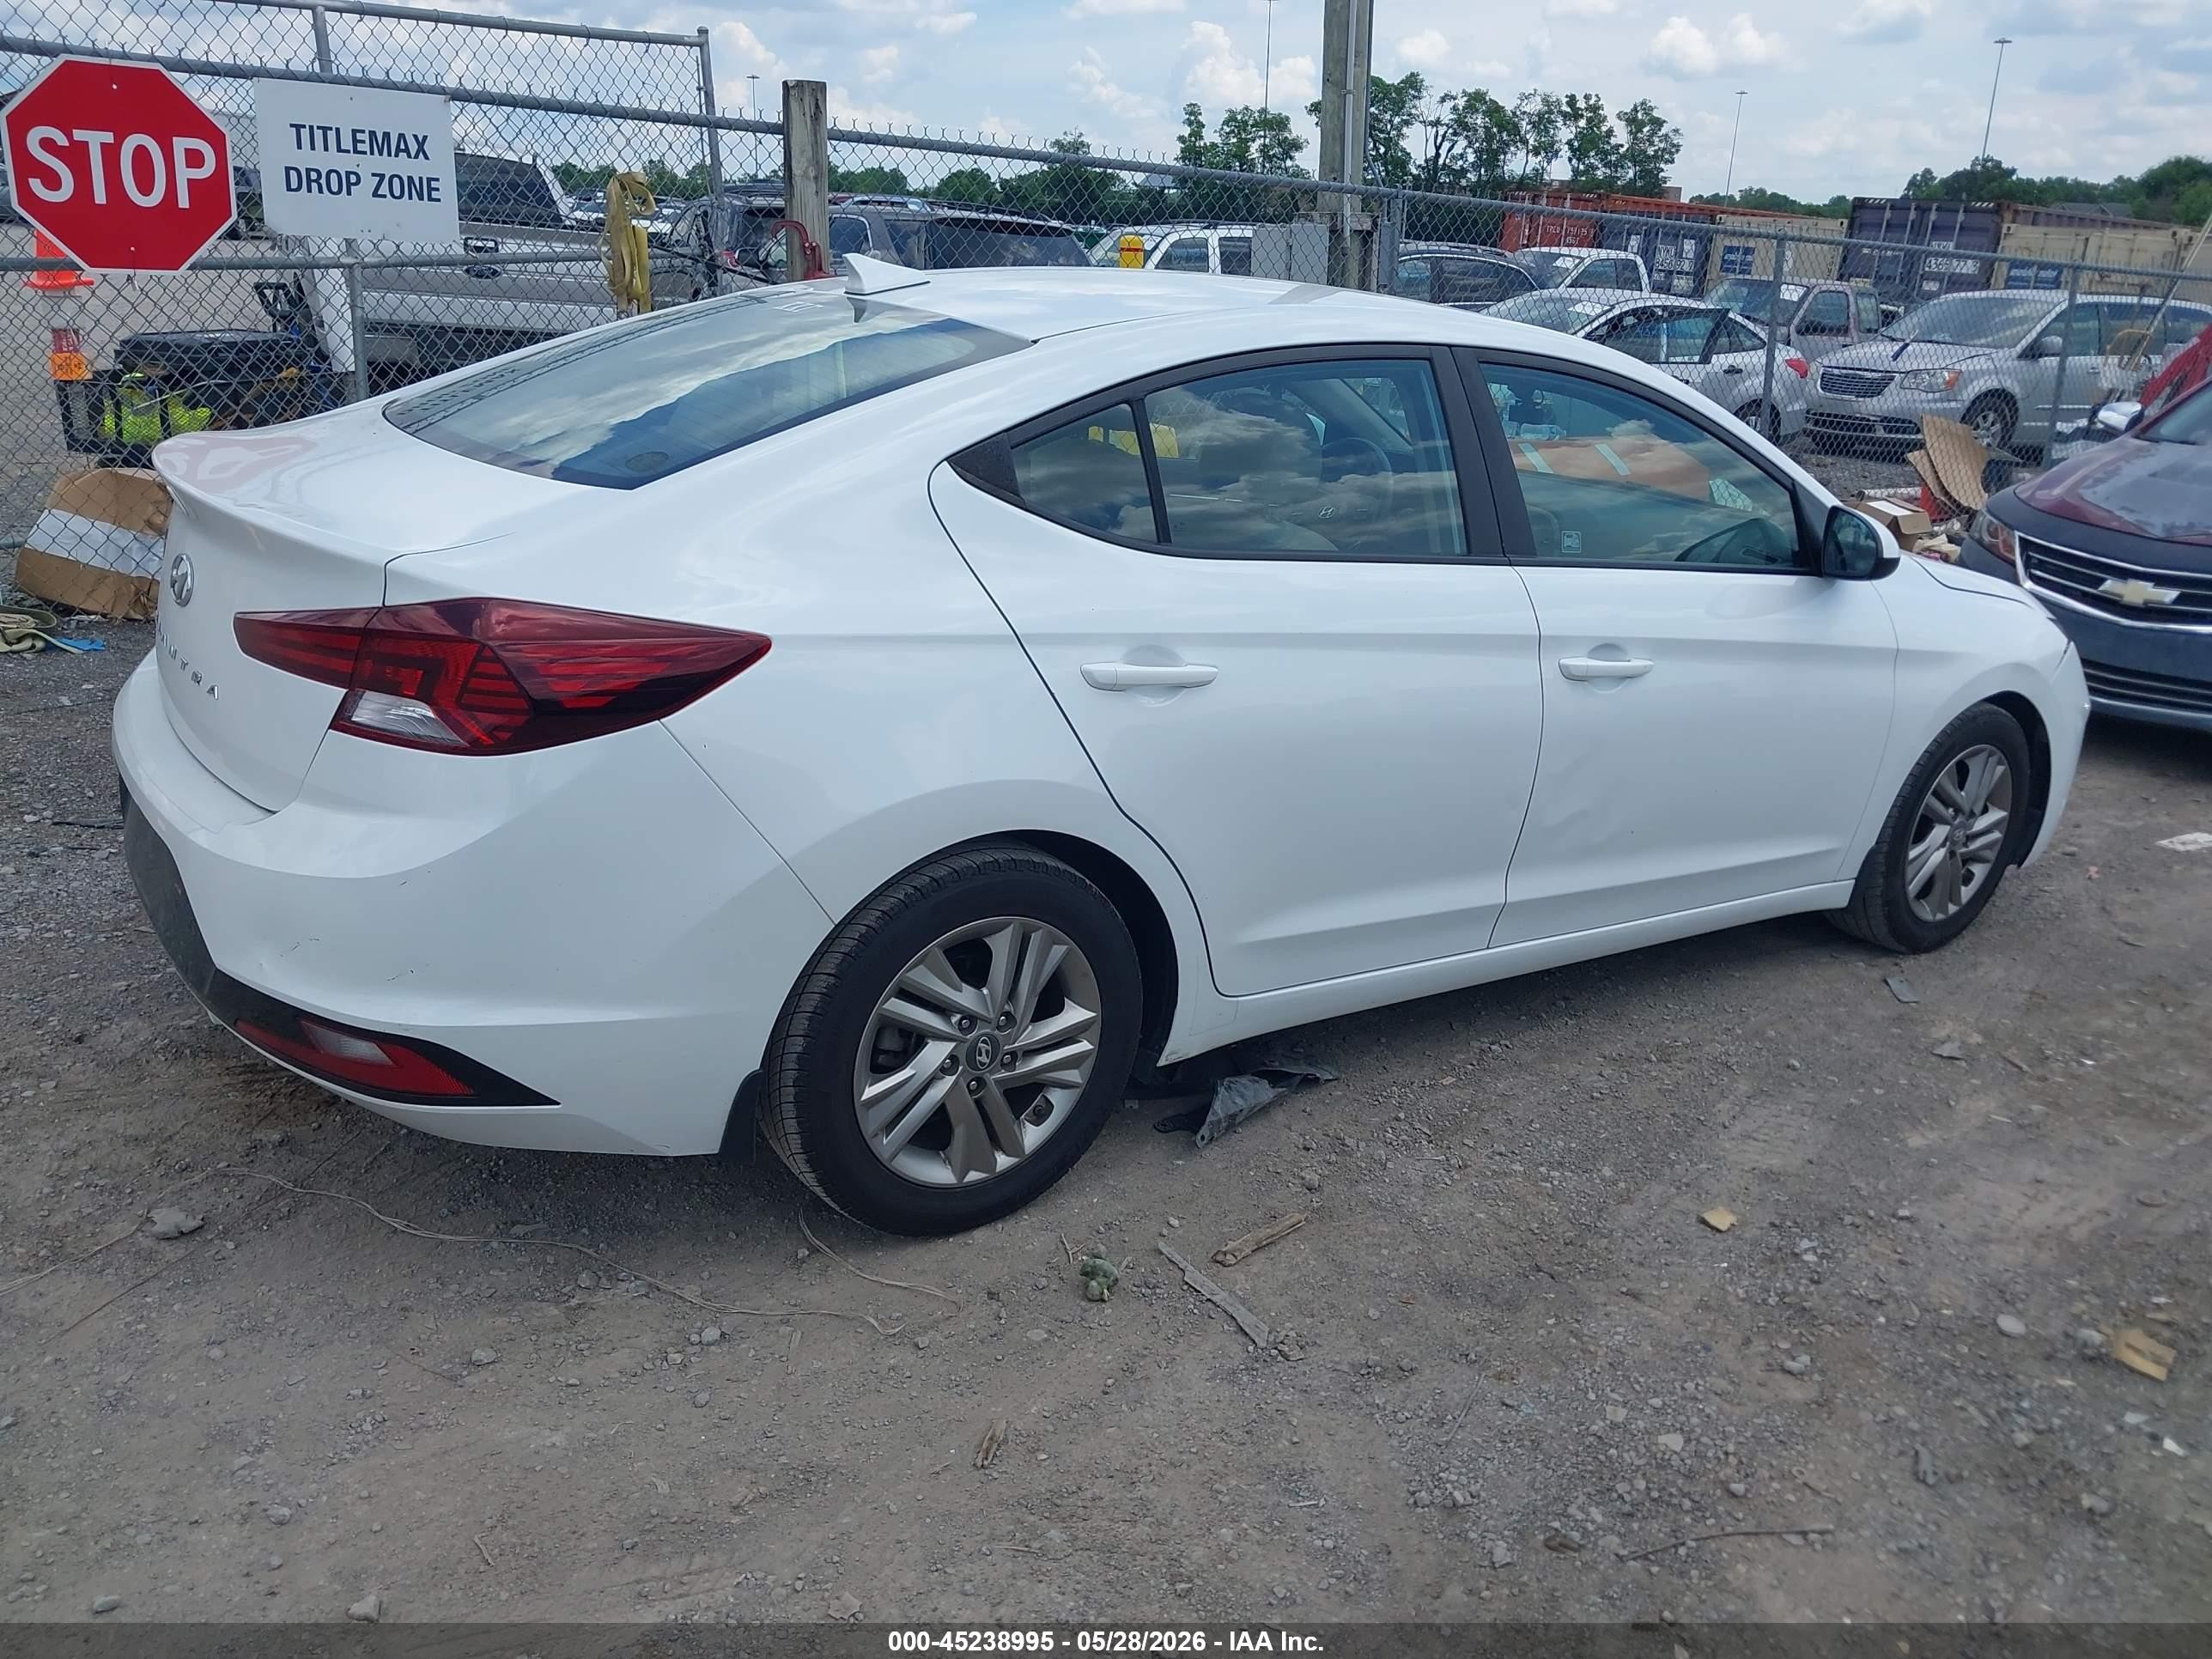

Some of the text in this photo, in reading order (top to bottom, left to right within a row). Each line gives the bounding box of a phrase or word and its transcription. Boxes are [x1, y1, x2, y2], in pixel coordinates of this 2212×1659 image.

[289, 124, 430, 161] TITLEMAX
[26, 125, 216, 209] STOP
[284, 166, 441, 203] DROP ZONE
